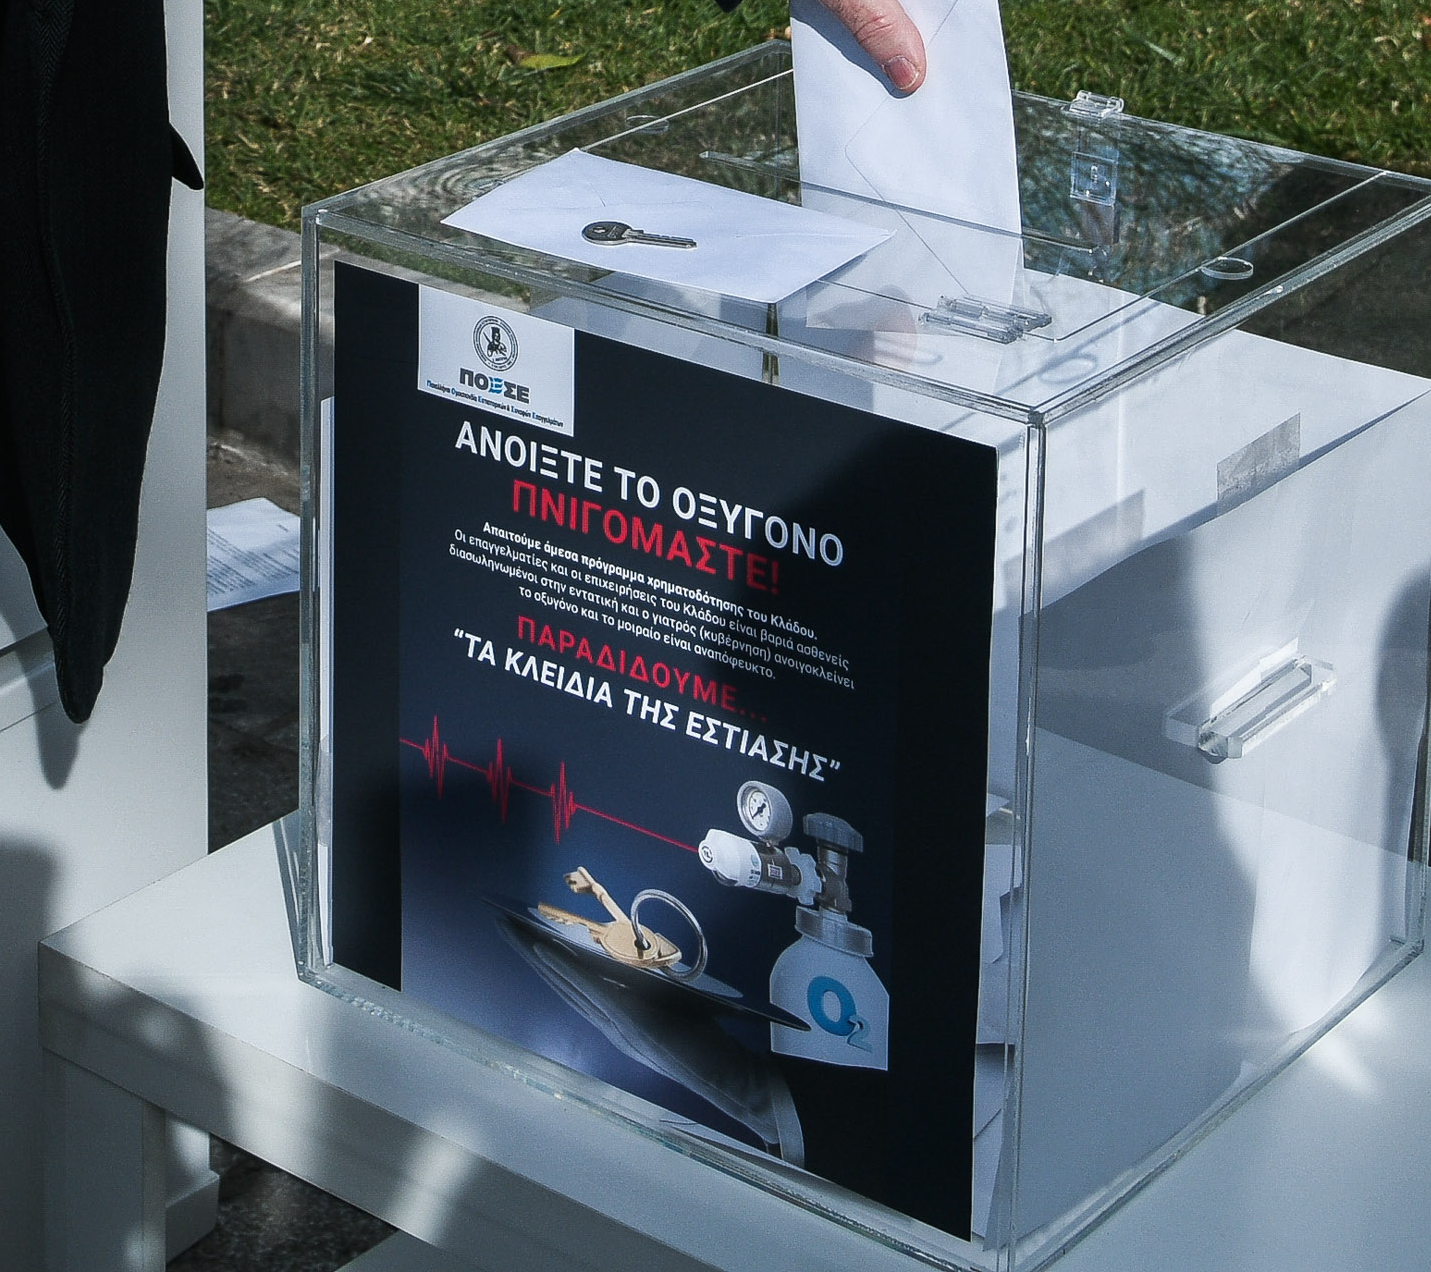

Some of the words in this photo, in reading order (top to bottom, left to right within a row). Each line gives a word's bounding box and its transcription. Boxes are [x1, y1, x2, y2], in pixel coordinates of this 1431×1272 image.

[455, 421, 603, 493] ΑΝΟΙΞΤΕ
[614, 466, 660, 509] ΤΟ
[672, 487, 844, 566] ΟΞΥΓΟΝΟ
[512, 479, 780, 595] ΠΝΙΓΟΜΑΣΤΕ!
[449, 543, 538, 584] διασωληνωμένοι
[541, 577, 566, 594] στην
[569, 586, 619, 613] εντατική
[621, 603, 639, 617] και
[642, 609, 650, 620] ο
[652, 611, 697, 637] γιατρός
[700, 625, 771, 661] (κυβέρνηση)
[774, 653, 855, 690] ανοιγοκλείνει
[455, 529, 466, 543] Οι
[469, 535, 548, 572] επαγγελματίες
[551, 562, 568, 577] και
[571, 568, 582, 581] οι
[585, 573, 657, 606] επιχειρήσεις
[660, 597, 680, 612] του
[683, 603, 726, 627] Κλάδου
[729, 619, 757, 638] είναι
[760, 629, 794, 649] βαριά
[797, 642, 849, 671] ασθενείς
[483, 522, 541, 551] Απαιτούμε
[544, 541, 578, 563] άμεσα
[581, 555, 645, 584] πρόγραμμα
[647, 575, 744, 617] χρηματοδότησης
[747, 608, 768, 623] του
[771, 614, 817, 640] Κλάδου.
[518, 585, 532, 599] το
[534, 589, 579, 614] οξυγόνο
[581, 606, 599, 621] και
[602, 613, 615, 626] το
[617, 618, 661, 642] μοιραίο
[663, 630, 691, 651] είναι
[694, 644, 776, 679] αναπόφευκτο.
[504, 647, 613, 708] ΚΛΕΙΔΙΑ
[624, 688, 679, 731] ΤΗΣ
[518, 615, 768, 722] ΠΑΡΑΔΙΔΟΥΜΕ...
